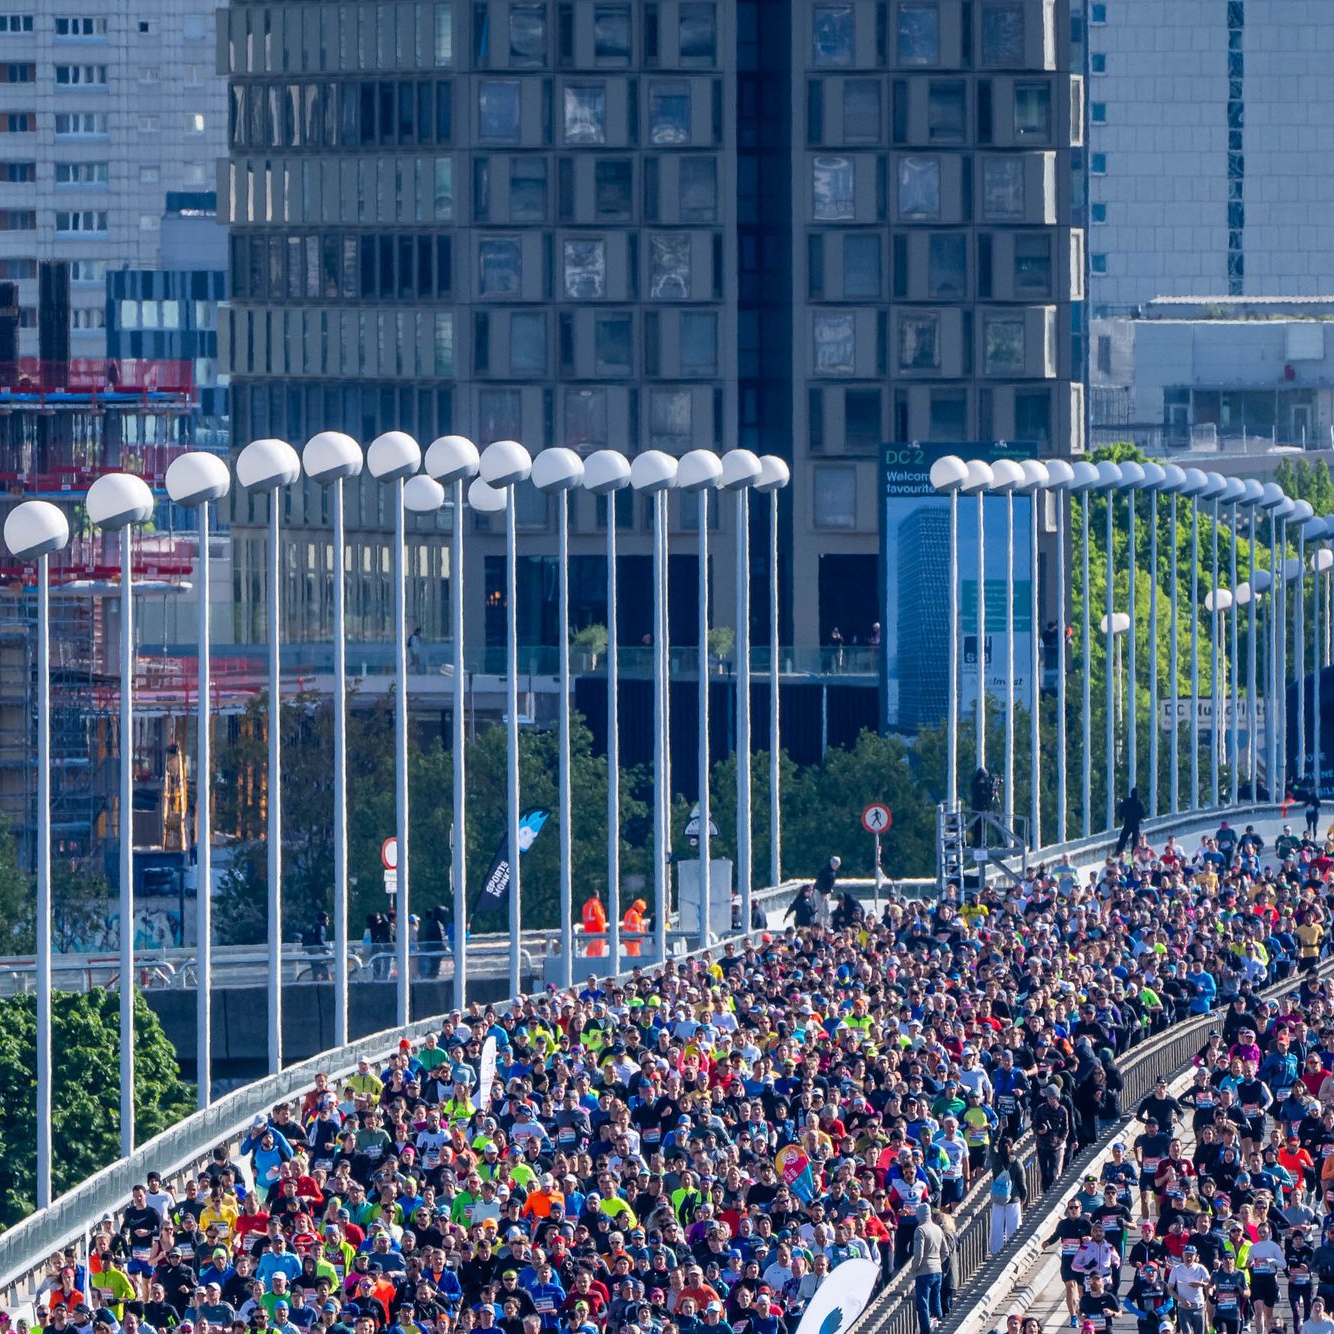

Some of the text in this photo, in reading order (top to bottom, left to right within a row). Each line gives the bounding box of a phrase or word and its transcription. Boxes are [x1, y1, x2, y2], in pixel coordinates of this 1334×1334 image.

[886, 450, 925, 465] DC 2
[485, 860, 509, 894] SPORTS
